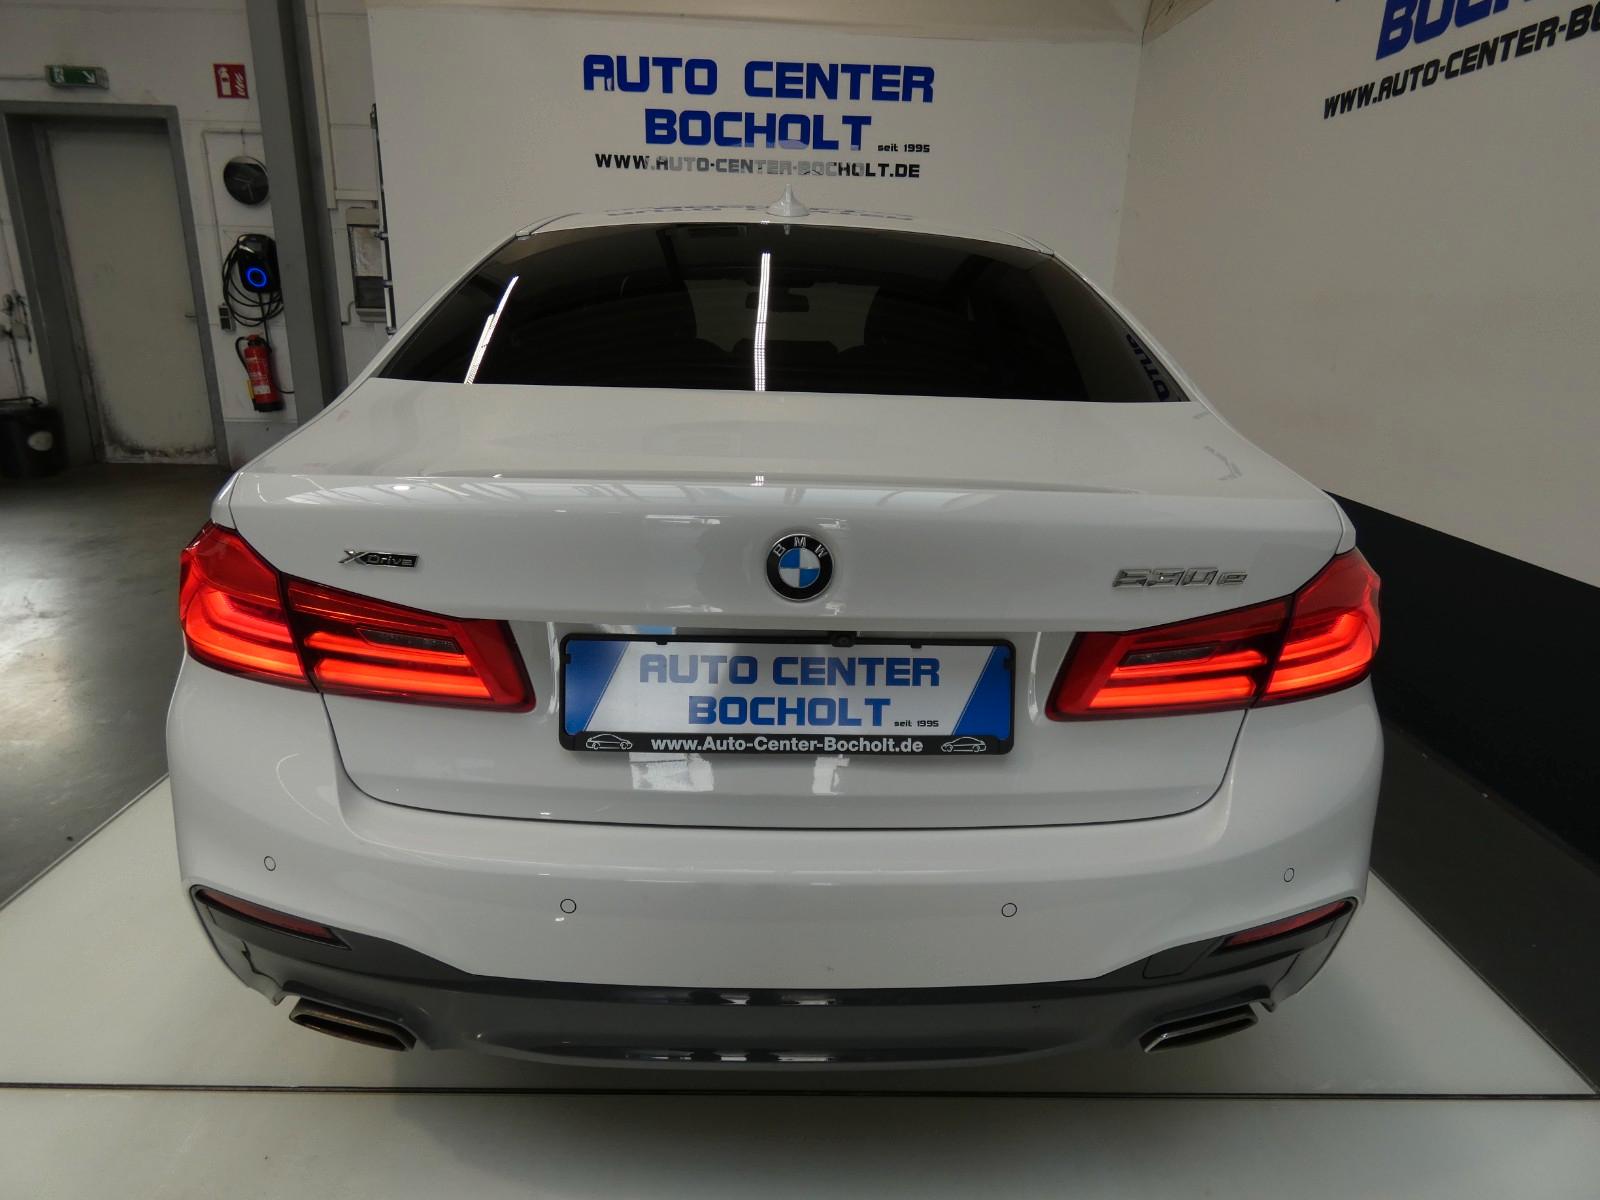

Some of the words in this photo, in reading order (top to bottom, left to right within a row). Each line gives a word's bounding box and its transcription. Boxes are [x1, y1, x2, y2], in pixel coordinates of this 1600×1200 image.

[583, 54, 717, 95] AUTO
[745, 61, 935, 103] CENTER
[645, 108, 872, 151] BOCHOLT
[877, 143, 899, 152] seit
[904, 144, 931, 153] 1995
[595, 153, 921, 178] WWW.AUTO-CENTER-BOCHOLT.DE
[773, 536, 828, 558] BMW
[640, 654, 757, 685] AUTO
[773, 656, 940, 687] CENTER
[689, 696, 891, 727] BOCHOLT
[894, 719, 912, 727] seit
[651, 736, 923, 753] www.Auto-Center-Bocholt.de
